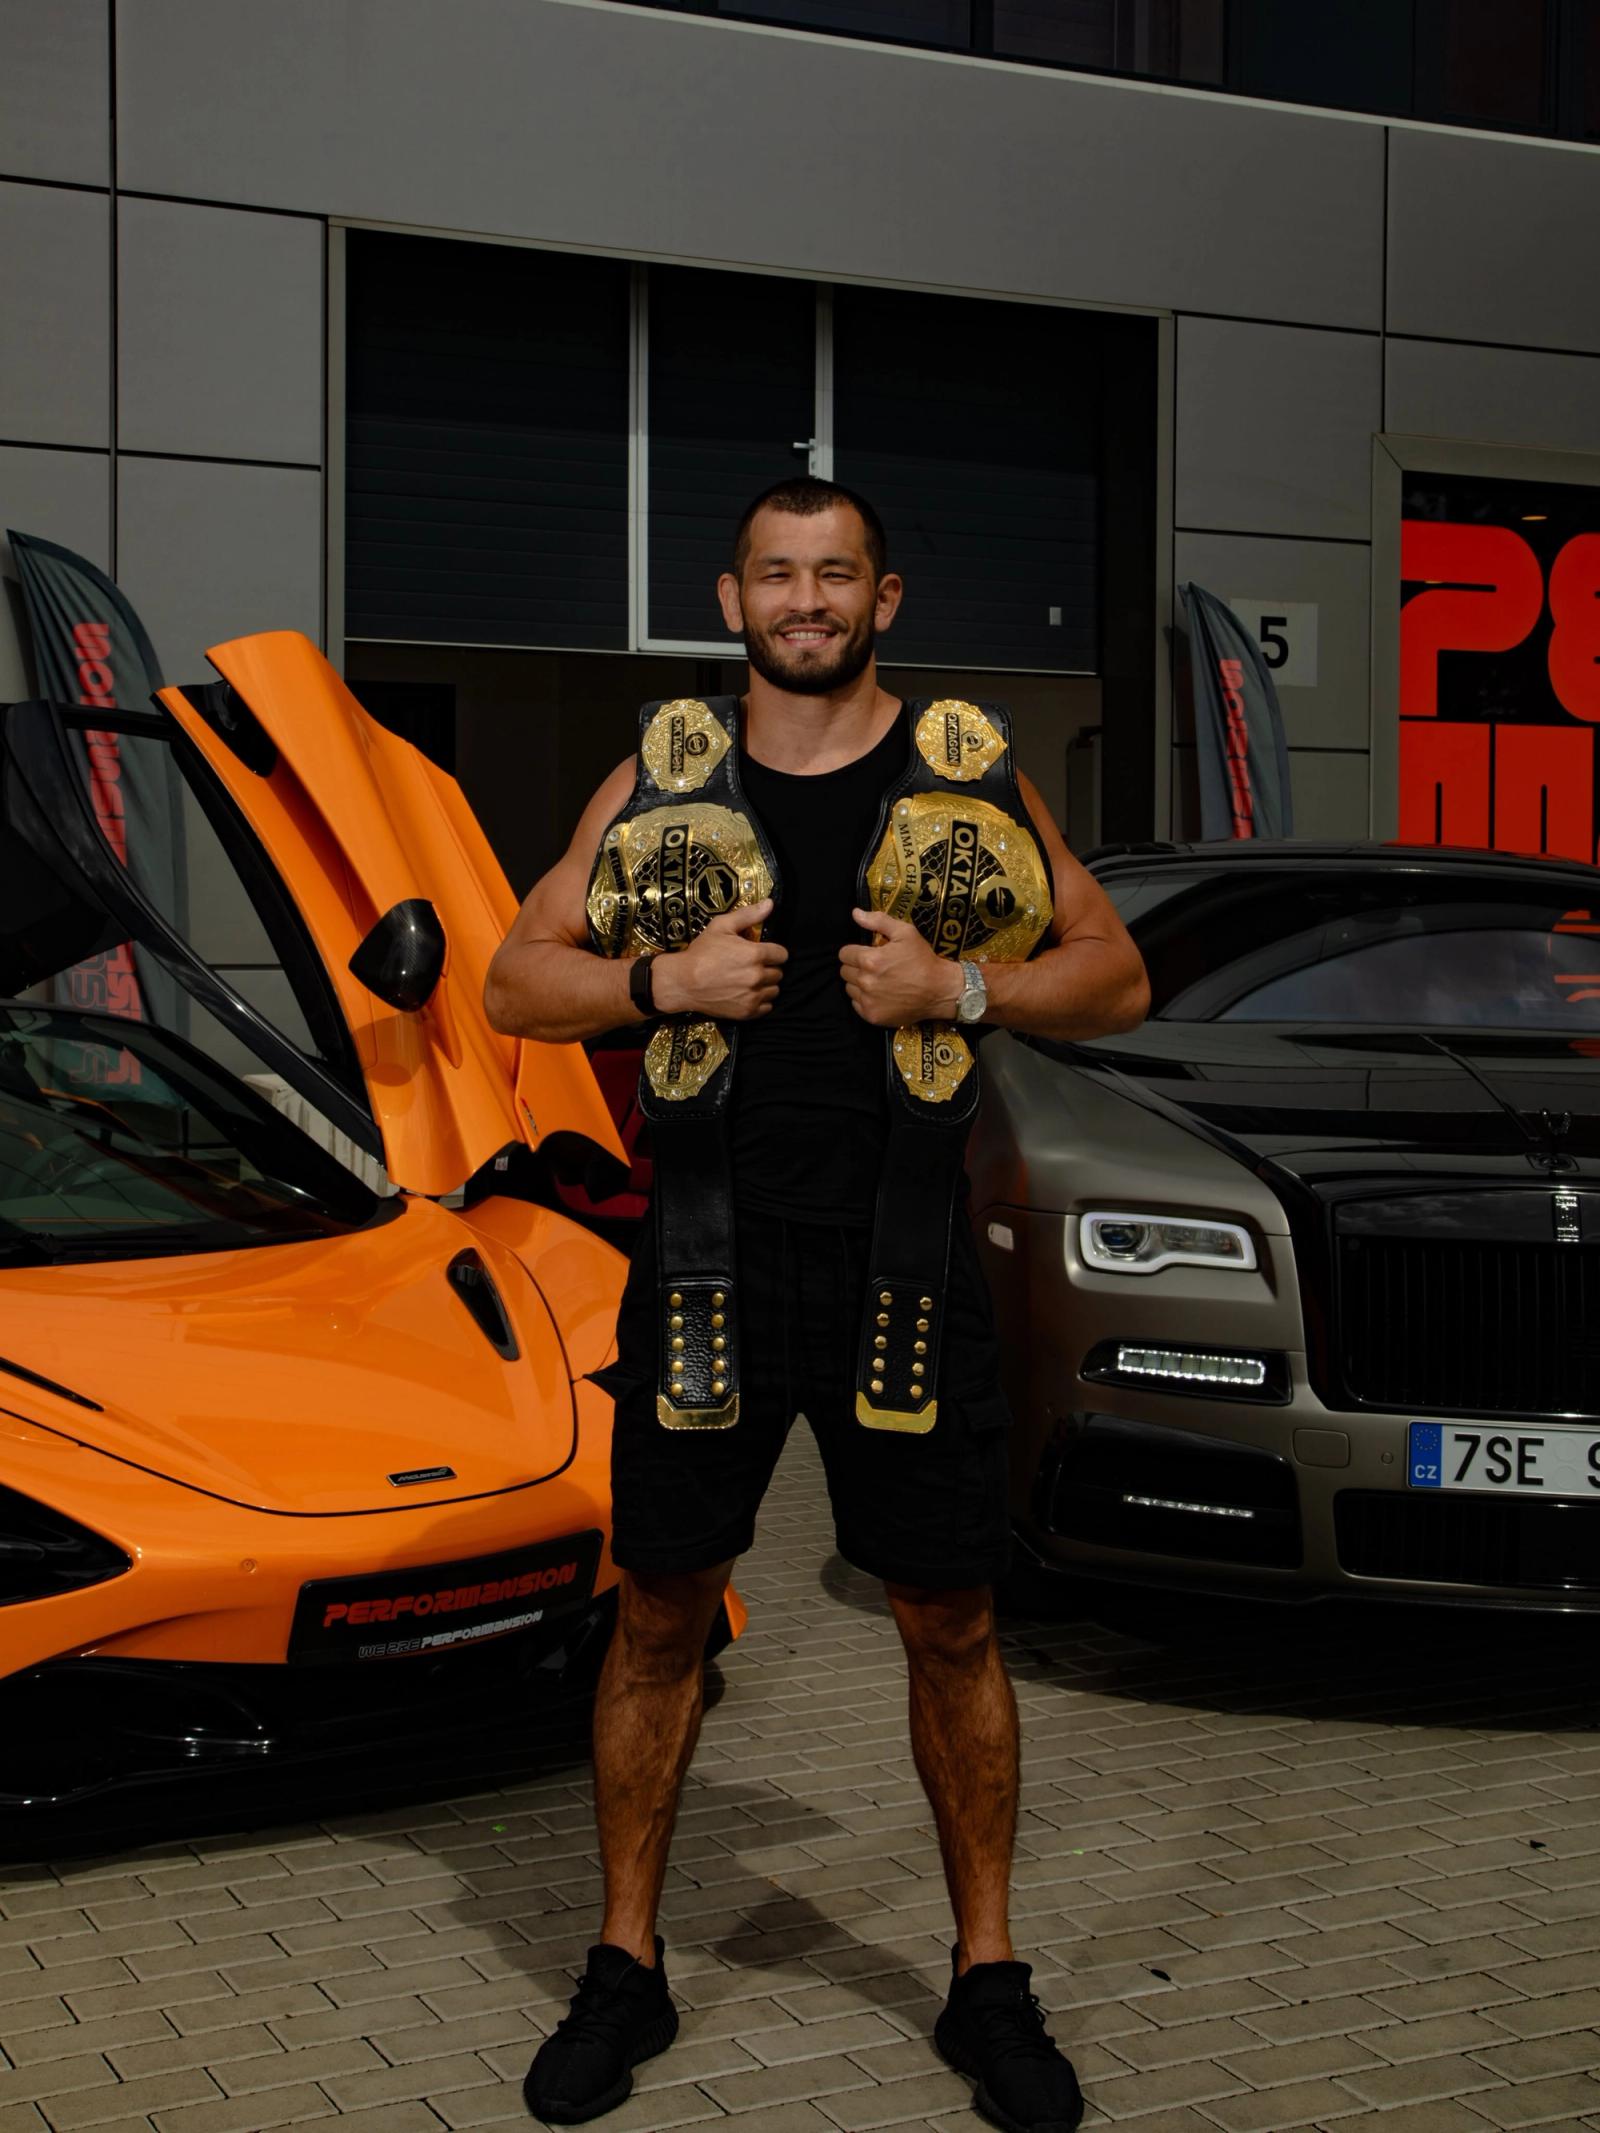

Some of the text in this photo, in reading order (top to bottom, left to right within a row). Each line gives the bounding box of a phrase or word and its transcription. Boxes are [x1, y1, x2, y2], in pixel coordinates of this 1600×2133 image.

[1259, 616, 1290, 670] 5
[672, 717, 684, 776] OKTAGON
[946, 713, 960, 764] OKTAGON
[898, 823, 915, 859] MMA
[608, 846, 627, 893] INTERIM
[922, 1023, 933, 1082] OKTAGON
[1414, 1464, 1438, 1480] CZ
[1454, 1433, 1544, 1486] 7SE
[323, 1561, 578, 1629] PERFORMANSION
[357, 1643, 387, 1659] WE
